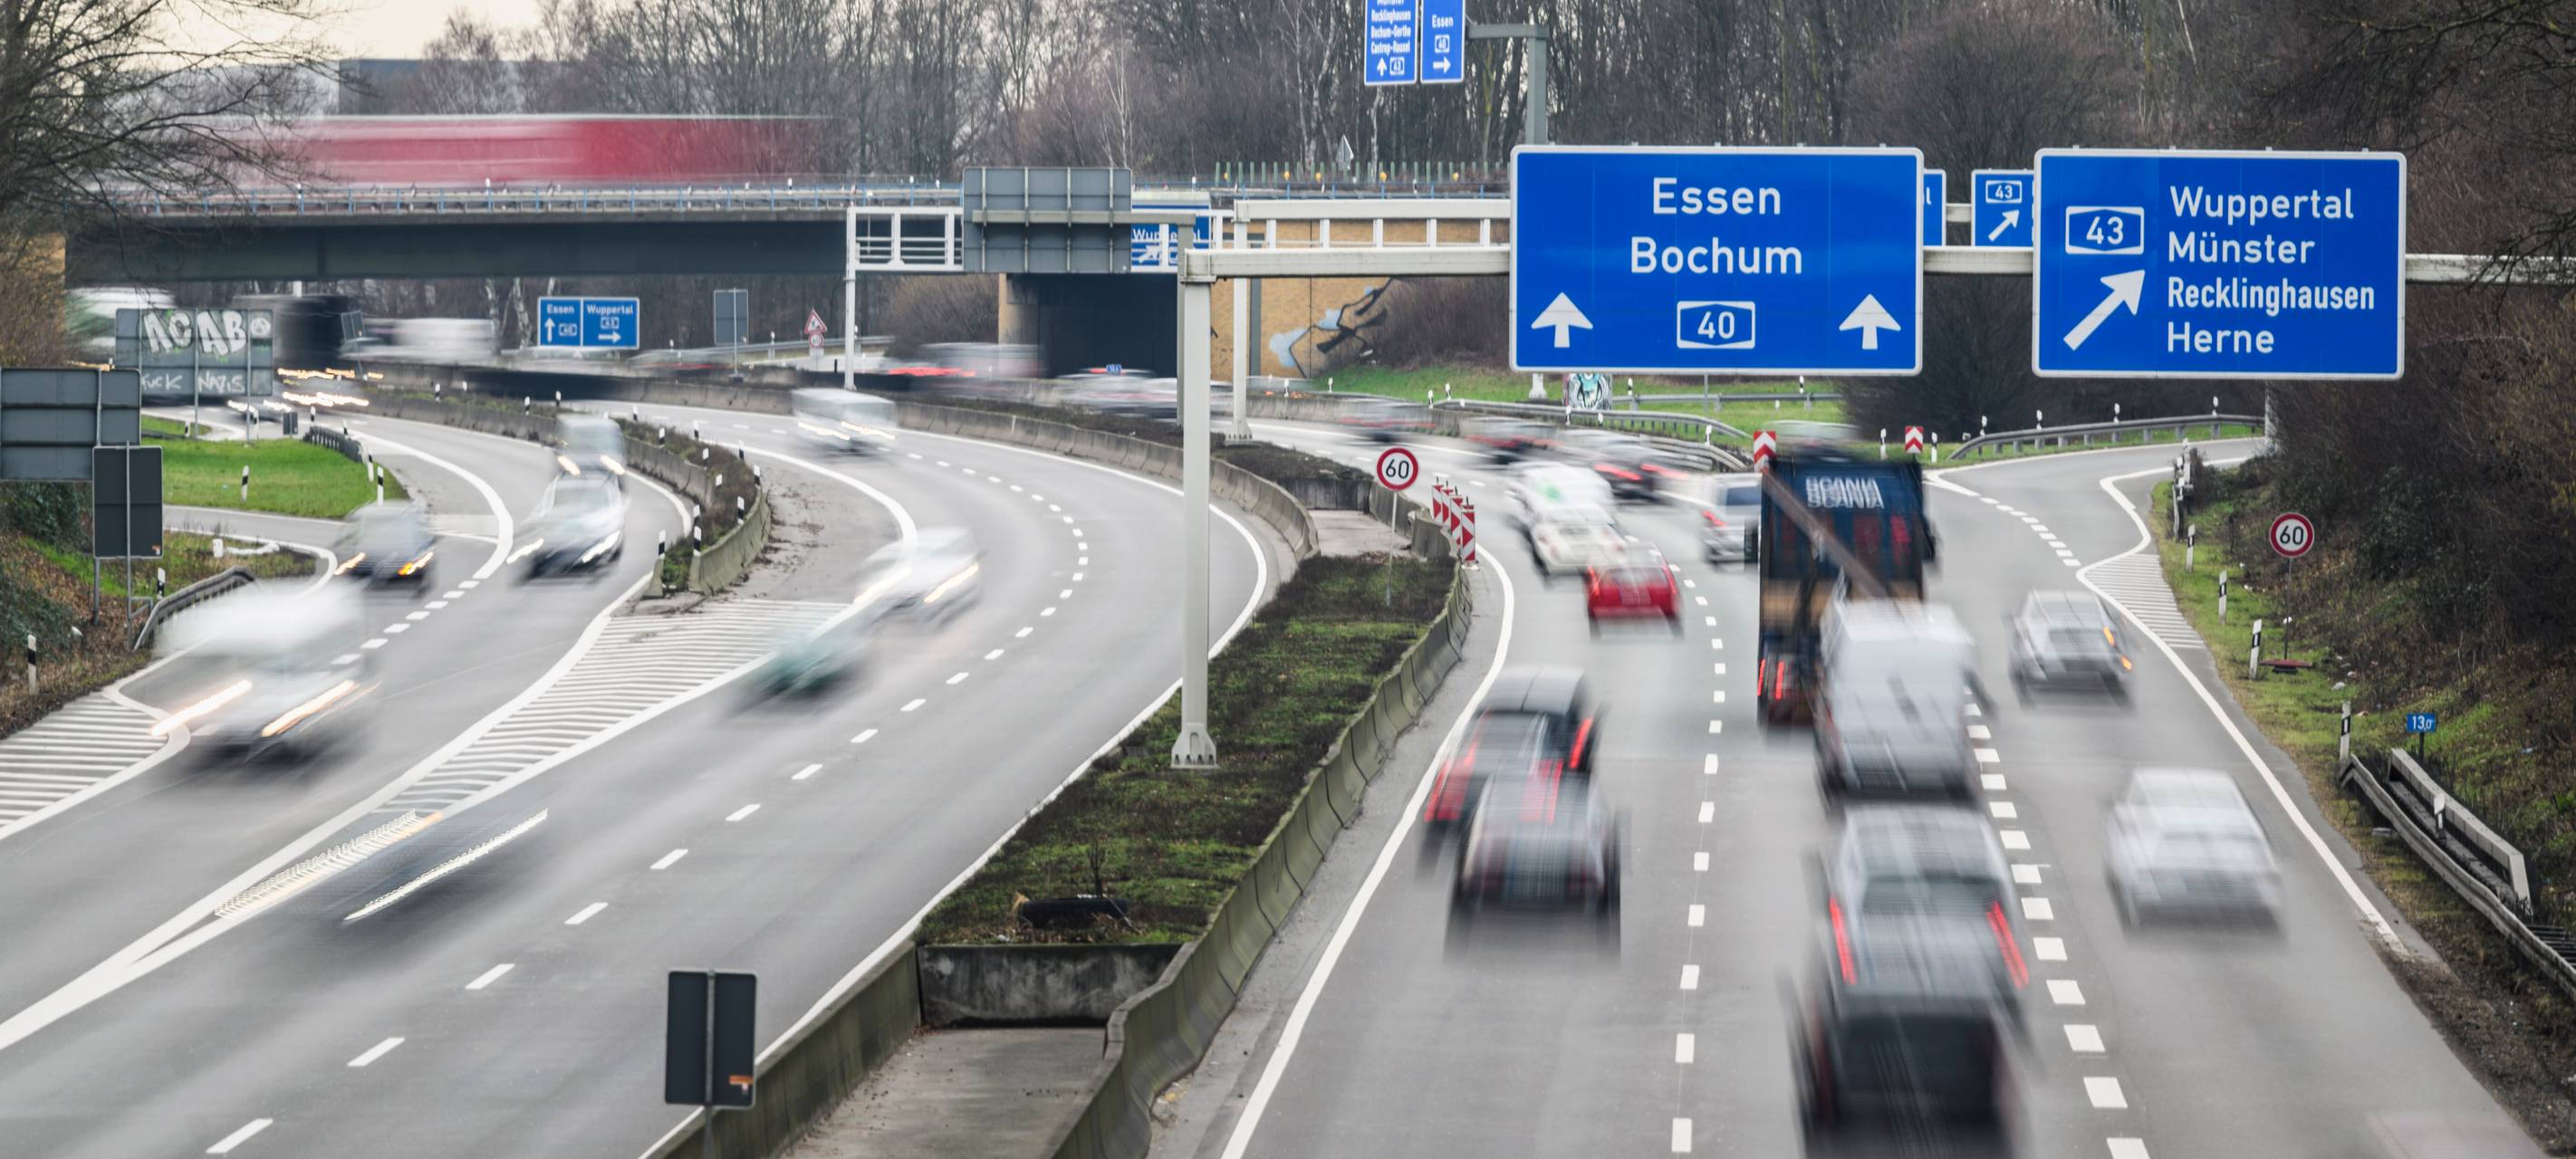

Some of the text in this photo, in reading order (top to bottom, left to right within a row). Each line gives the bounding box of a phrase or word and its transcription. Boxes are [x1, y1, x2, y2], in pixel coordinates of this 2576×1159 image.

[1432, 14, 1454, 28] Essen
[1438, 38, 1447, 51] 40
[1653, 177, 1781, 215] Essen
[1994, 185, 2013, 199] 43
[2170, 186, 2354, 225] Wuppertal
[2086, 216, 2124, 244] 43
[1630, 236, 1802, 274] Bochum
[2168, 231, 2315, 263] Münster
[547, 304, 574, 314] Essen
[587, 304, 633, 316] Wuppertal
[2168, 276, 2374, 317] Recklinghausen
[143, 311, 246, 355] ACAB
[1697, 311, 1735, 339] 40
[2167, 321, 2274, 354] Herne
[1386, 459, 1409, 479] 60
[2280, 525, 2304, 545] 60
